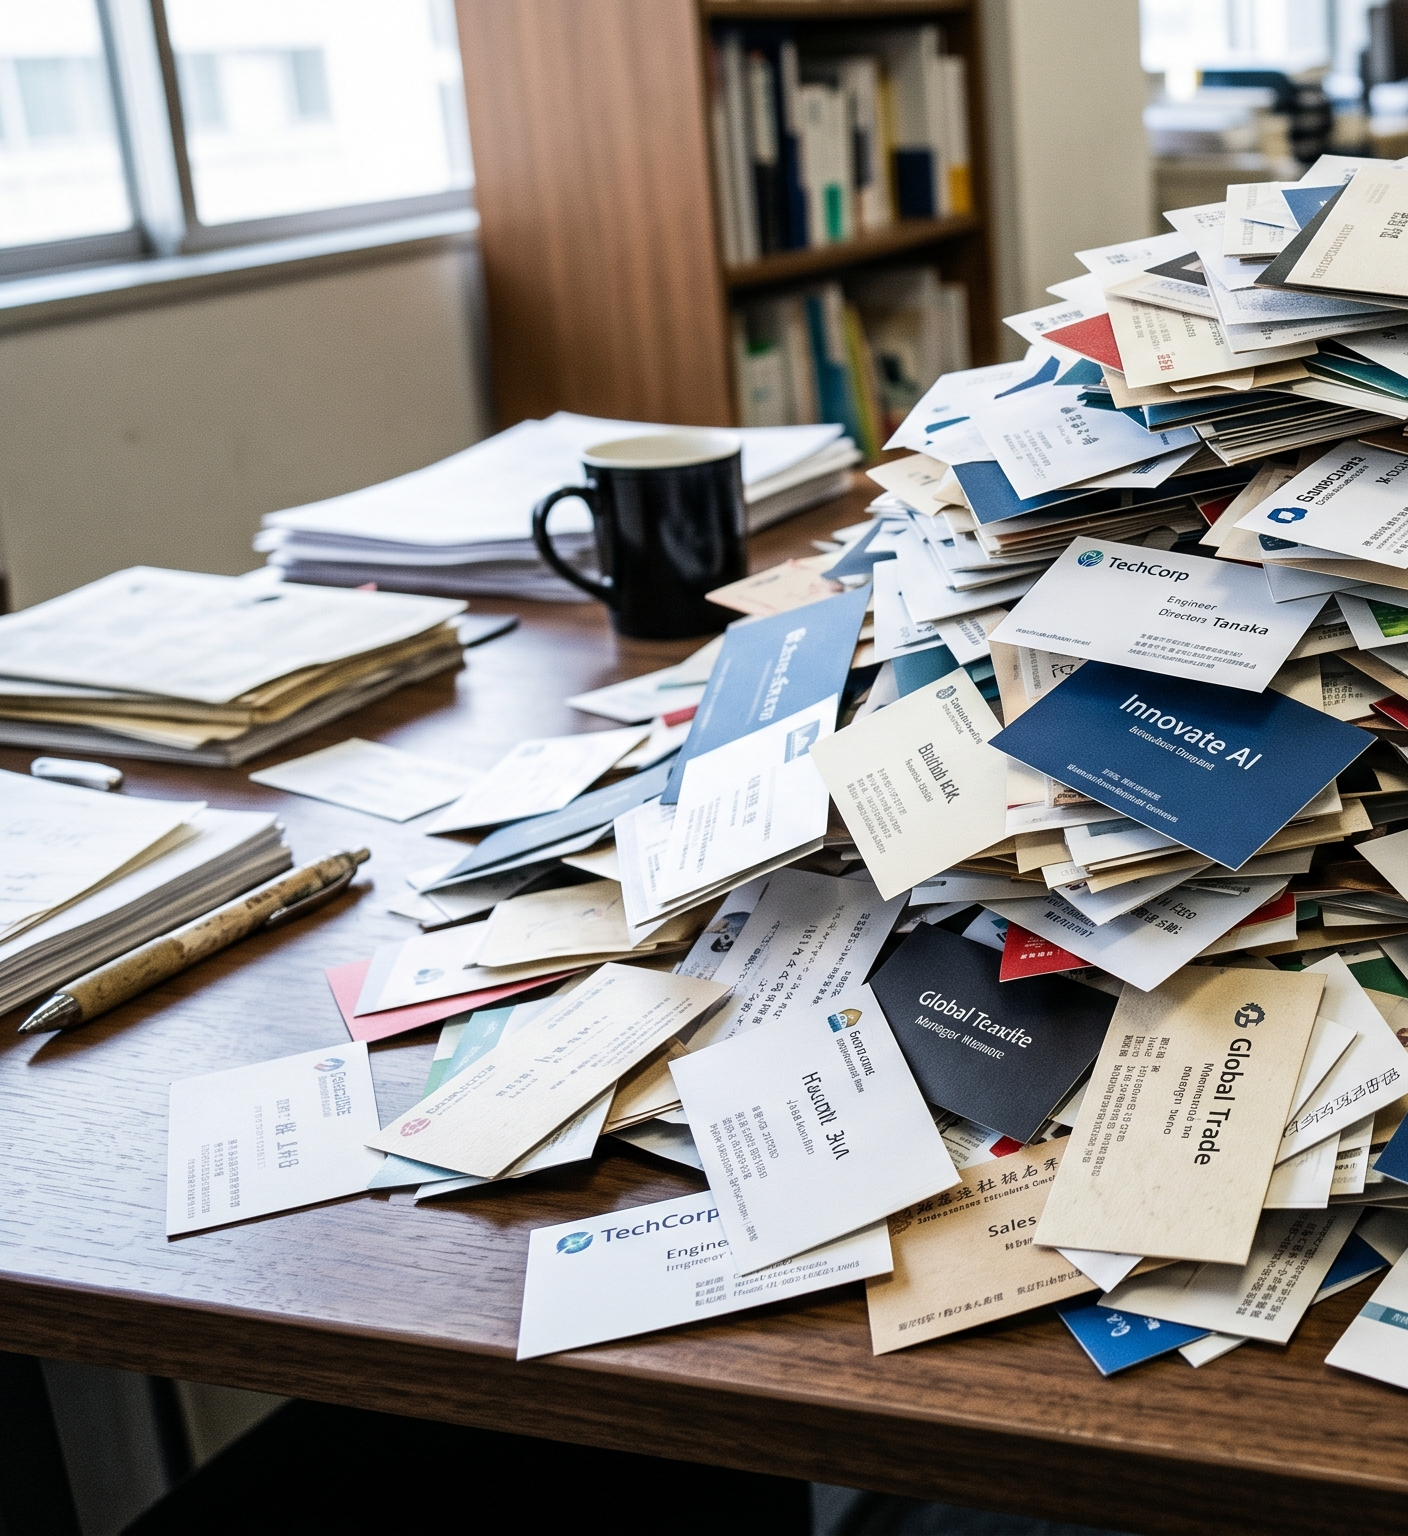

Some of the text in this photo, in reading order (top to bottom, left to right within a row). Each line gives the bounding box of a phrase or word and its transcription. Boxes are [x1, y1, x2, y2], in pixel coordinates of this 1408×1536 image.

[1108, 556, 1190, 583] TechCorp
[1166, 595, 1218, 611] Engineer
[1212, 617, 1269, 636] Tanaka
[1118, 693, 1227, 755] Innovate
[1225, 747, 1263, 771] AI
[919, 990, 976, 1022] Global
[1193, 1038, 1252, 1166] Global Trade
[600, 1208, 720, 1243] TechCorp
[988, 1215, 1037, 1238] Sales
